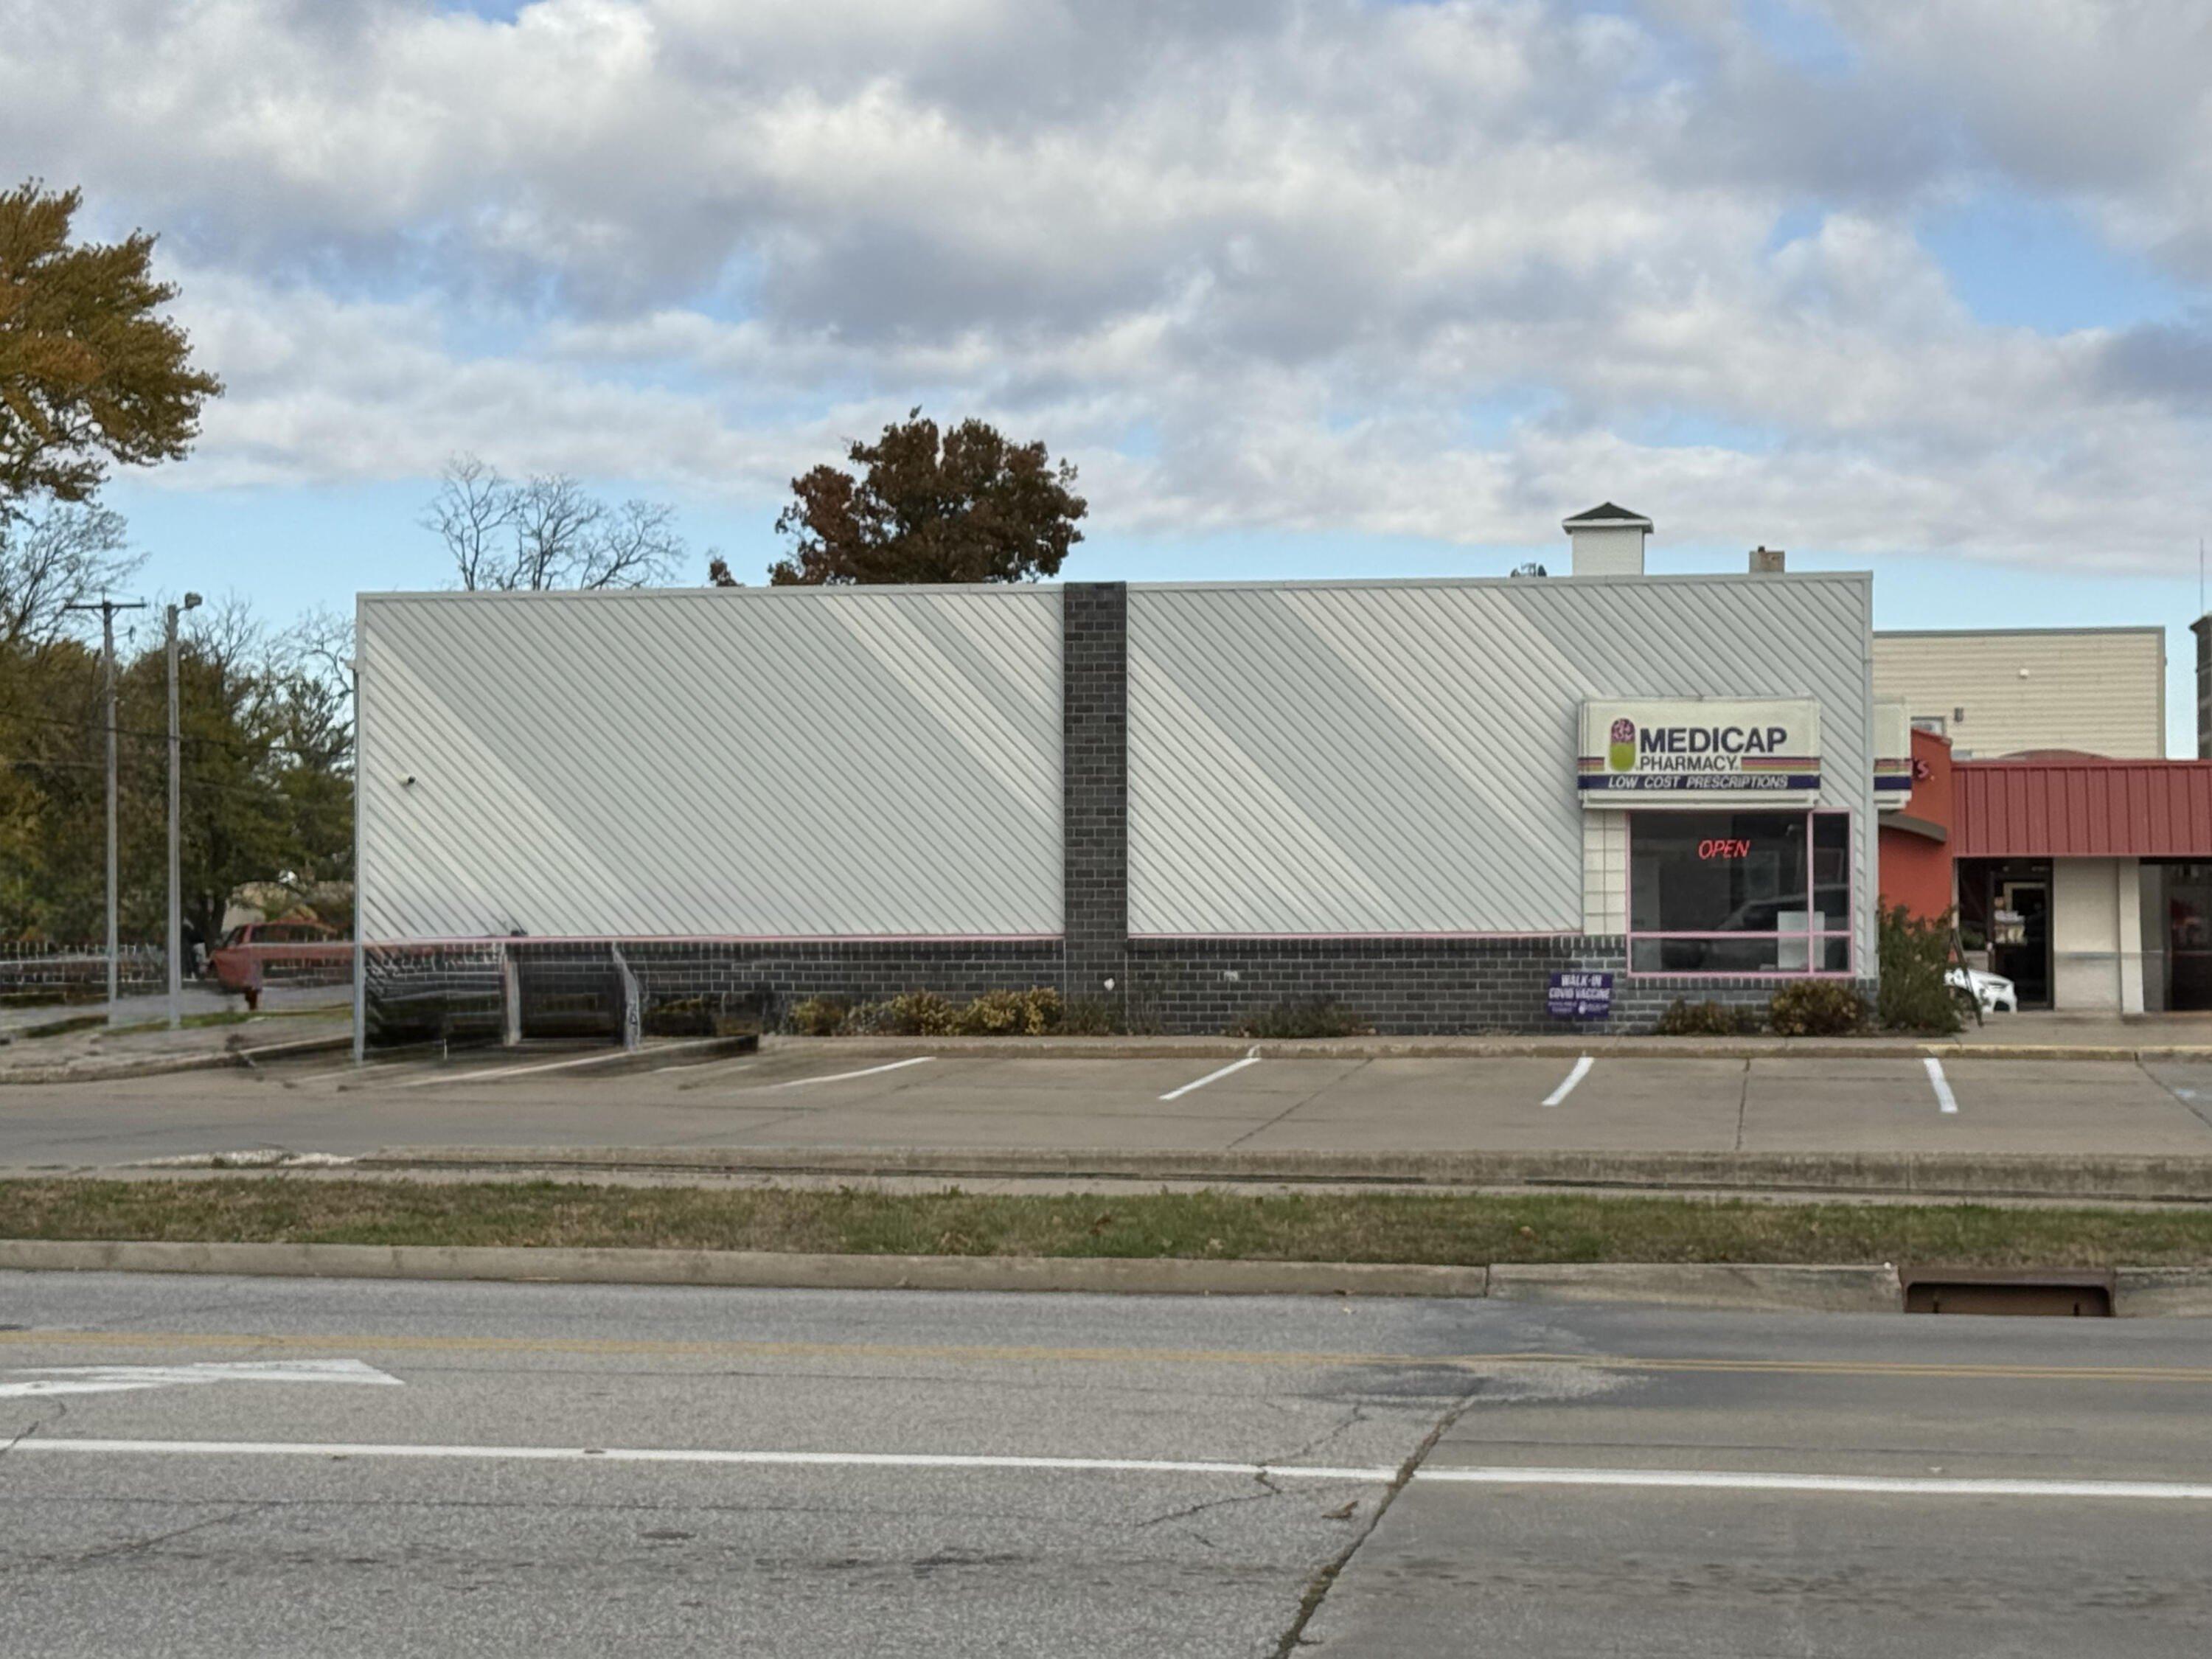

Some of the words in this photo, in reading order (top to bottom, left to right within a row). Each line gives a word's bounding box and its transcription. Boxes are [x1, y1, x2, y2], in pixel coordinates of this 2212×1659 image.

[1639, 726, 1788, 754] MEDICAP
[1639, 755, 1737, 772] PHARMACY
[1608, 776, 1639, 789] LOW
[1644, 776, 1681, 789] COST
[1686, 776, 1789, 789] PRESCRIPTIONS
[1698, 839, 1750, 860] OPEN
